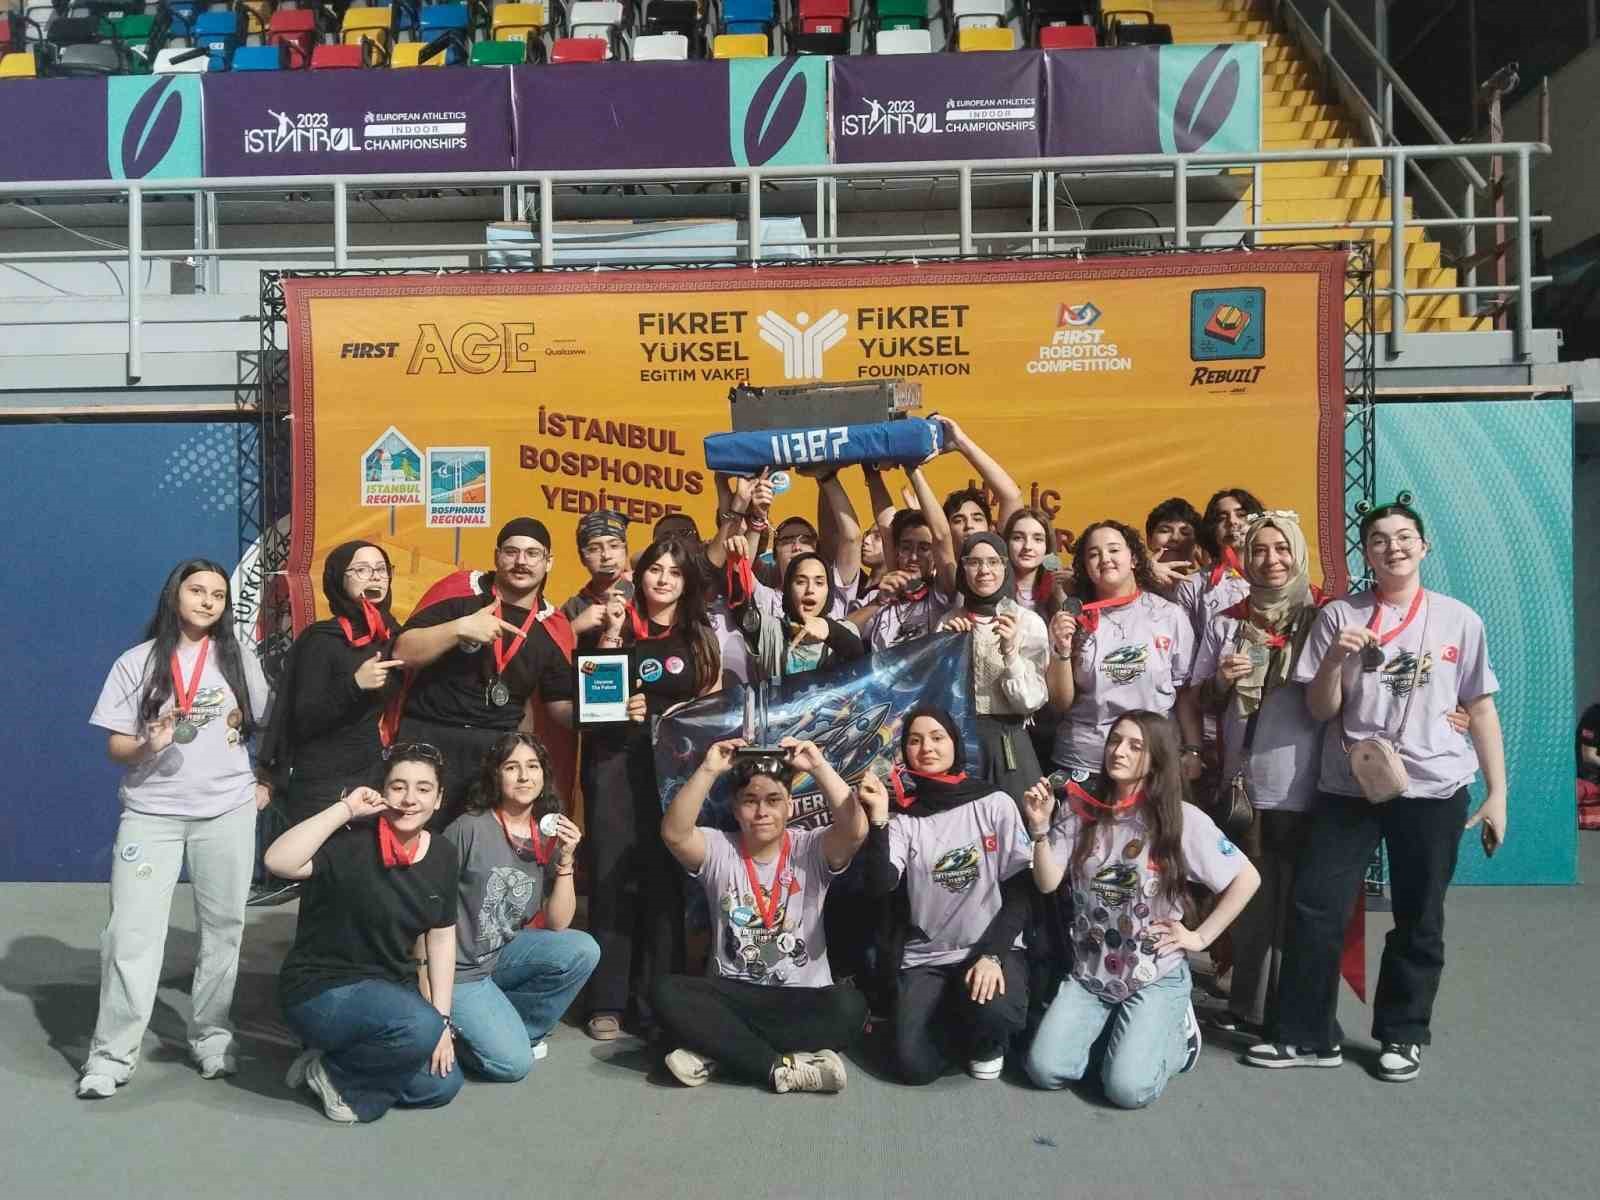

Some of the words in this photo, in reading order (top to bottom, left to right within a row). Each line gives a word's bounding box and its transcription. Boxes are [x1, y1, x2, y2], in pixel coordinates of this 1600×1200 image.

[888, 101, 915, 113] 2023
[956, 99, 995, 107] EUROPEAN
[996, 98, 1035, 106] ATHLETICS
[297, 113, 329, 129] 2023
[376, 112, 420, 122] EUROPEAN
[422, 111, 466, 121] ATHLETICS
[969, 110, 1012, 118] INDOOR
[391, 125, 439, 134] INDOOR
[945, 121, 1036, 133] CHAMPIONSHIPS
[364, 138, 468, 151] CHAMPIONSHIPS
[1052, 329, 1104, 345] FIRST
[340, 342, 400, 359] FIRST
[406, 322, 537, 375] AGE
[640, 341, 750, 362] YÜKSEL
[858, 336, 970, 359] YÜKSEL
[1039, 344, 1118, 359] ROBOTICS
[858, 363, 970, 378] FOUNDATION
[1026, 357, 1132, 374] COMPETITION
[700, 367, 750, 381] VAKFI
[771, 426, 849, 465] 11387
[519, 444, 704, 495] BOSPHORUS
[366, 495, 421, 504] REGIONAL
[431, 506, 486, 514] BOSPHORUS
[431, 515, 486, 524] REGIONAL
[233, 556, 265, 625] TÜRKİY
